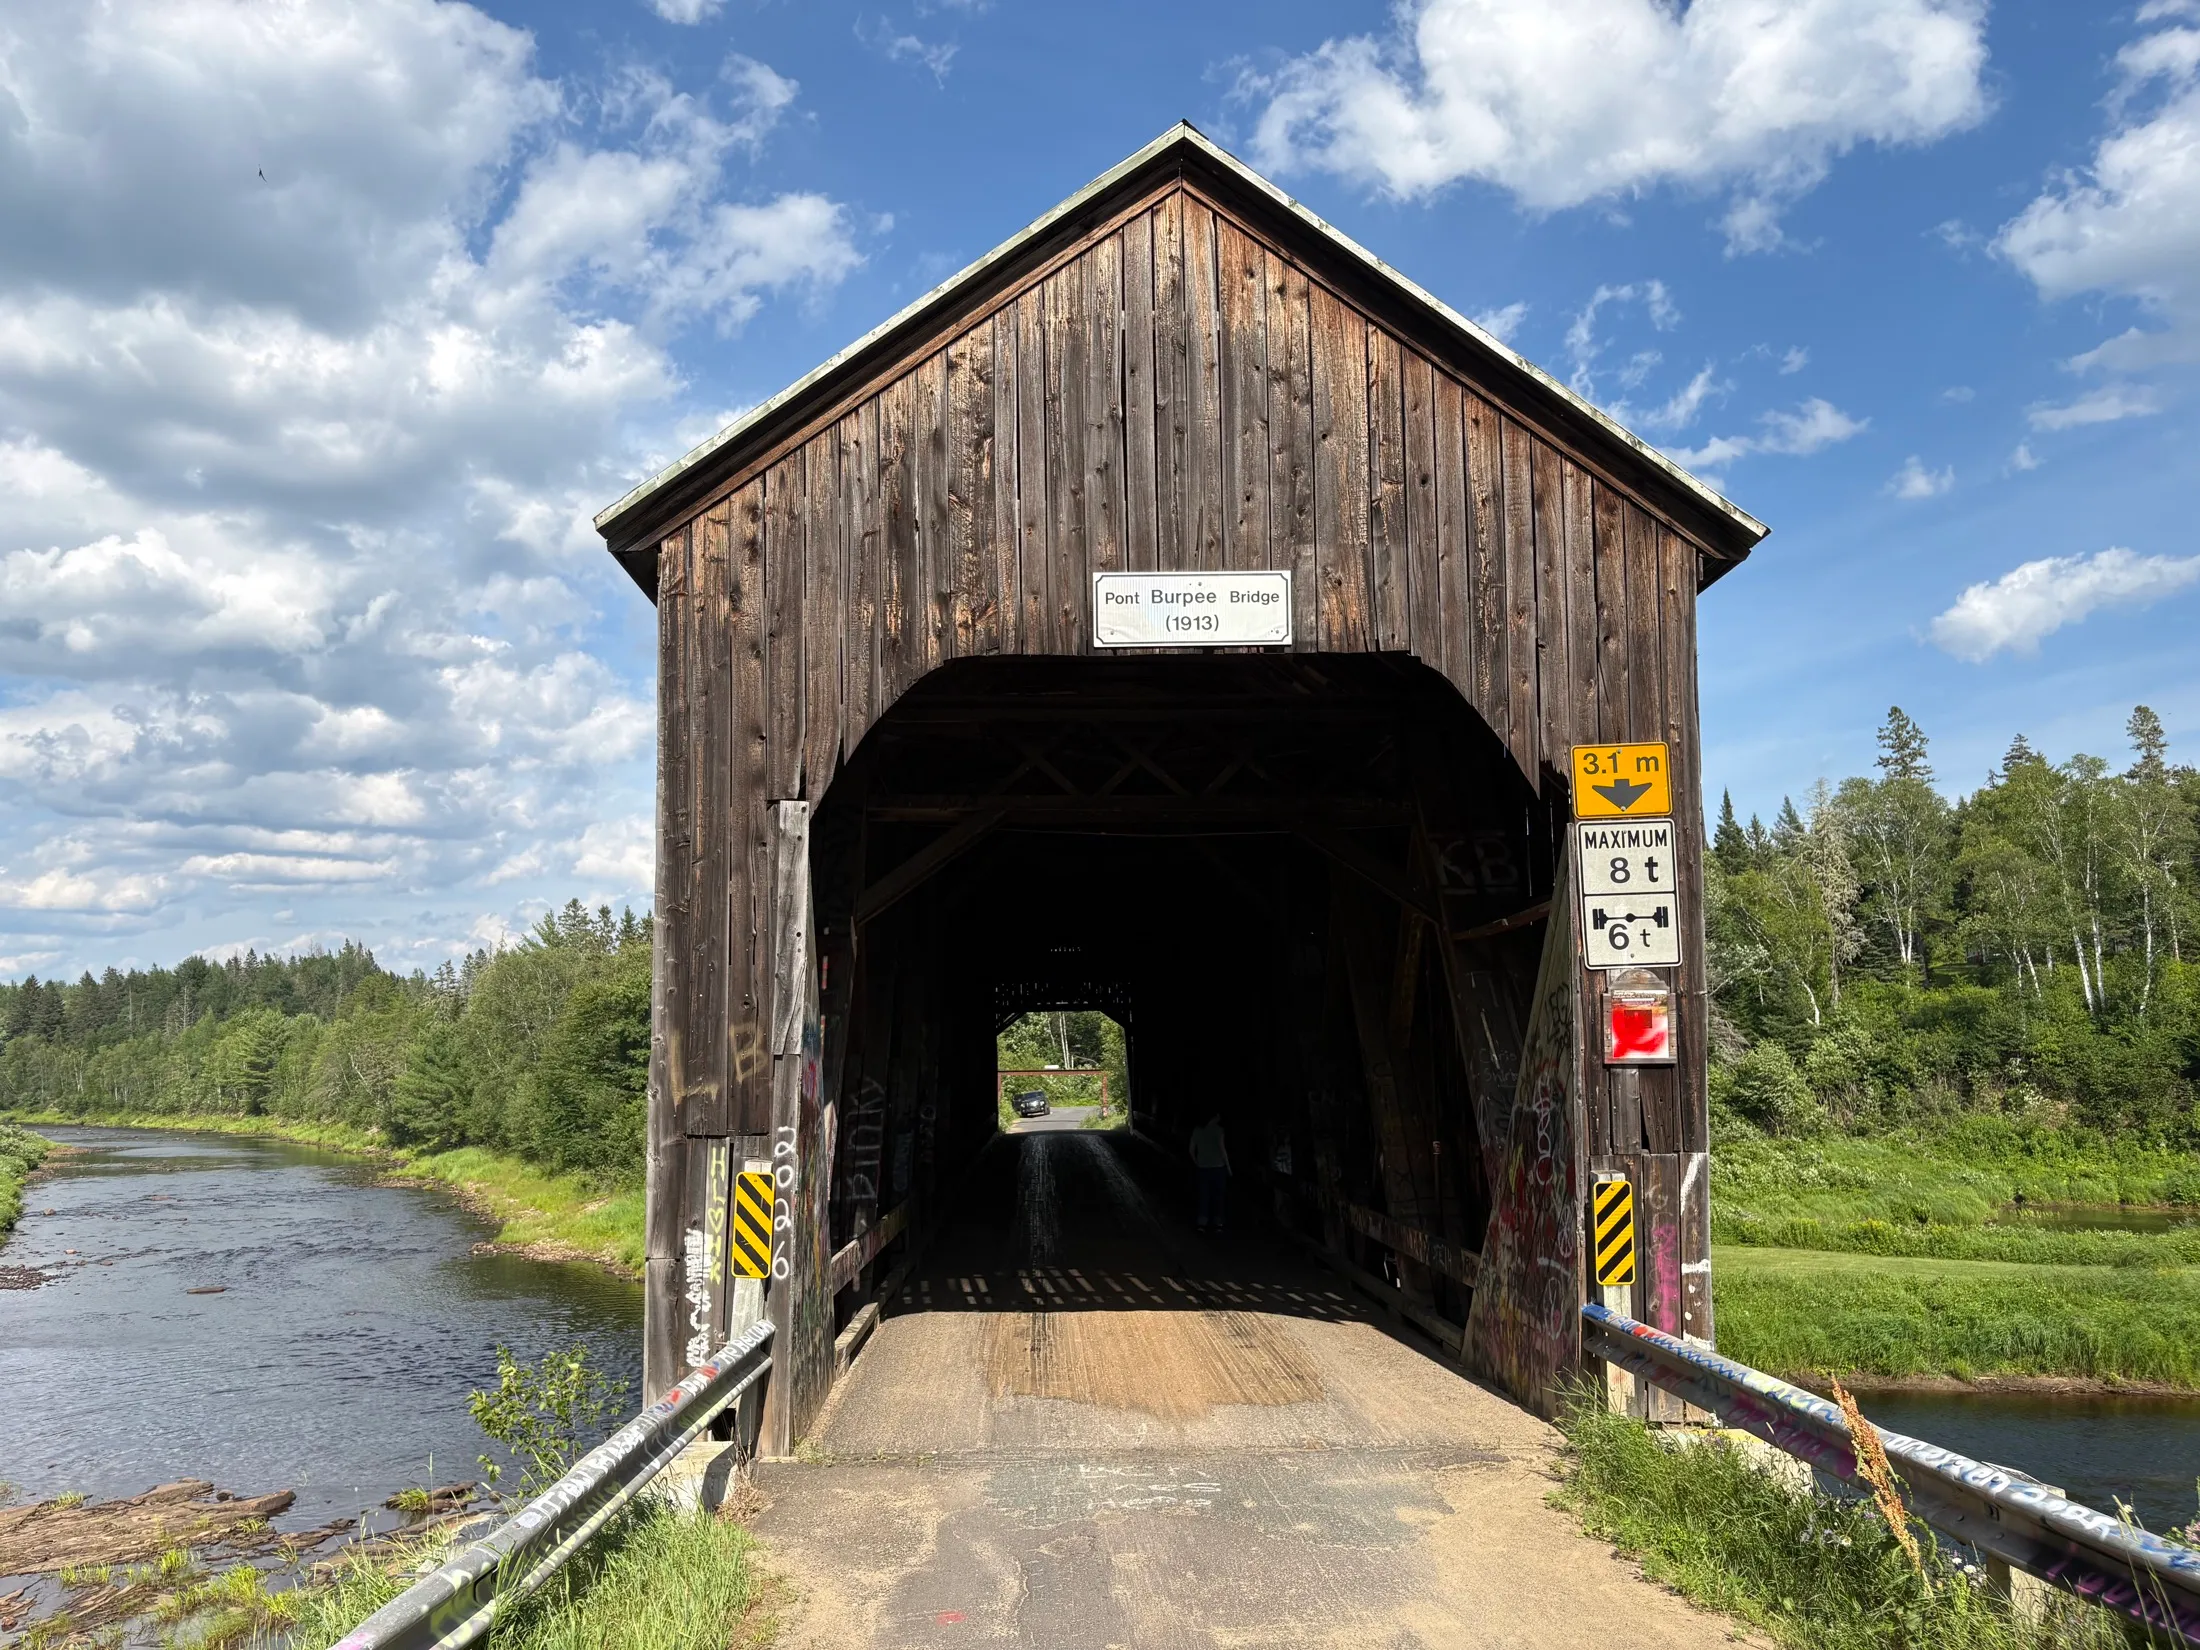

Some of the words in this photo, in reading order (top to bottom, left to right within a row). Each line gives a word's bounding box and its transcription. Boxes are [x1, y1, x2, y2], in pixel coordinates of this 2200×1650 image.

[1105, 591, 1140, 605] Pont
[1151, 589, 1217, 607] Burpee
[1229, 590, 1280, 606] Bridge
[1165, 614, 1220, 633] (1913)
[1583, 752, 1619, 775] 3.1
[1636, 755, 1660, 773] m
[1584, 829, 1668, 850] MAXIMUM
[1609, 856, 1631, 884] 8
[1644, 855, 1659, 883] t
[1608, 923, 1630, 950] 6
[1639, 928, 1651, 948] t
[772, 1126, 797, 1280] 2026
